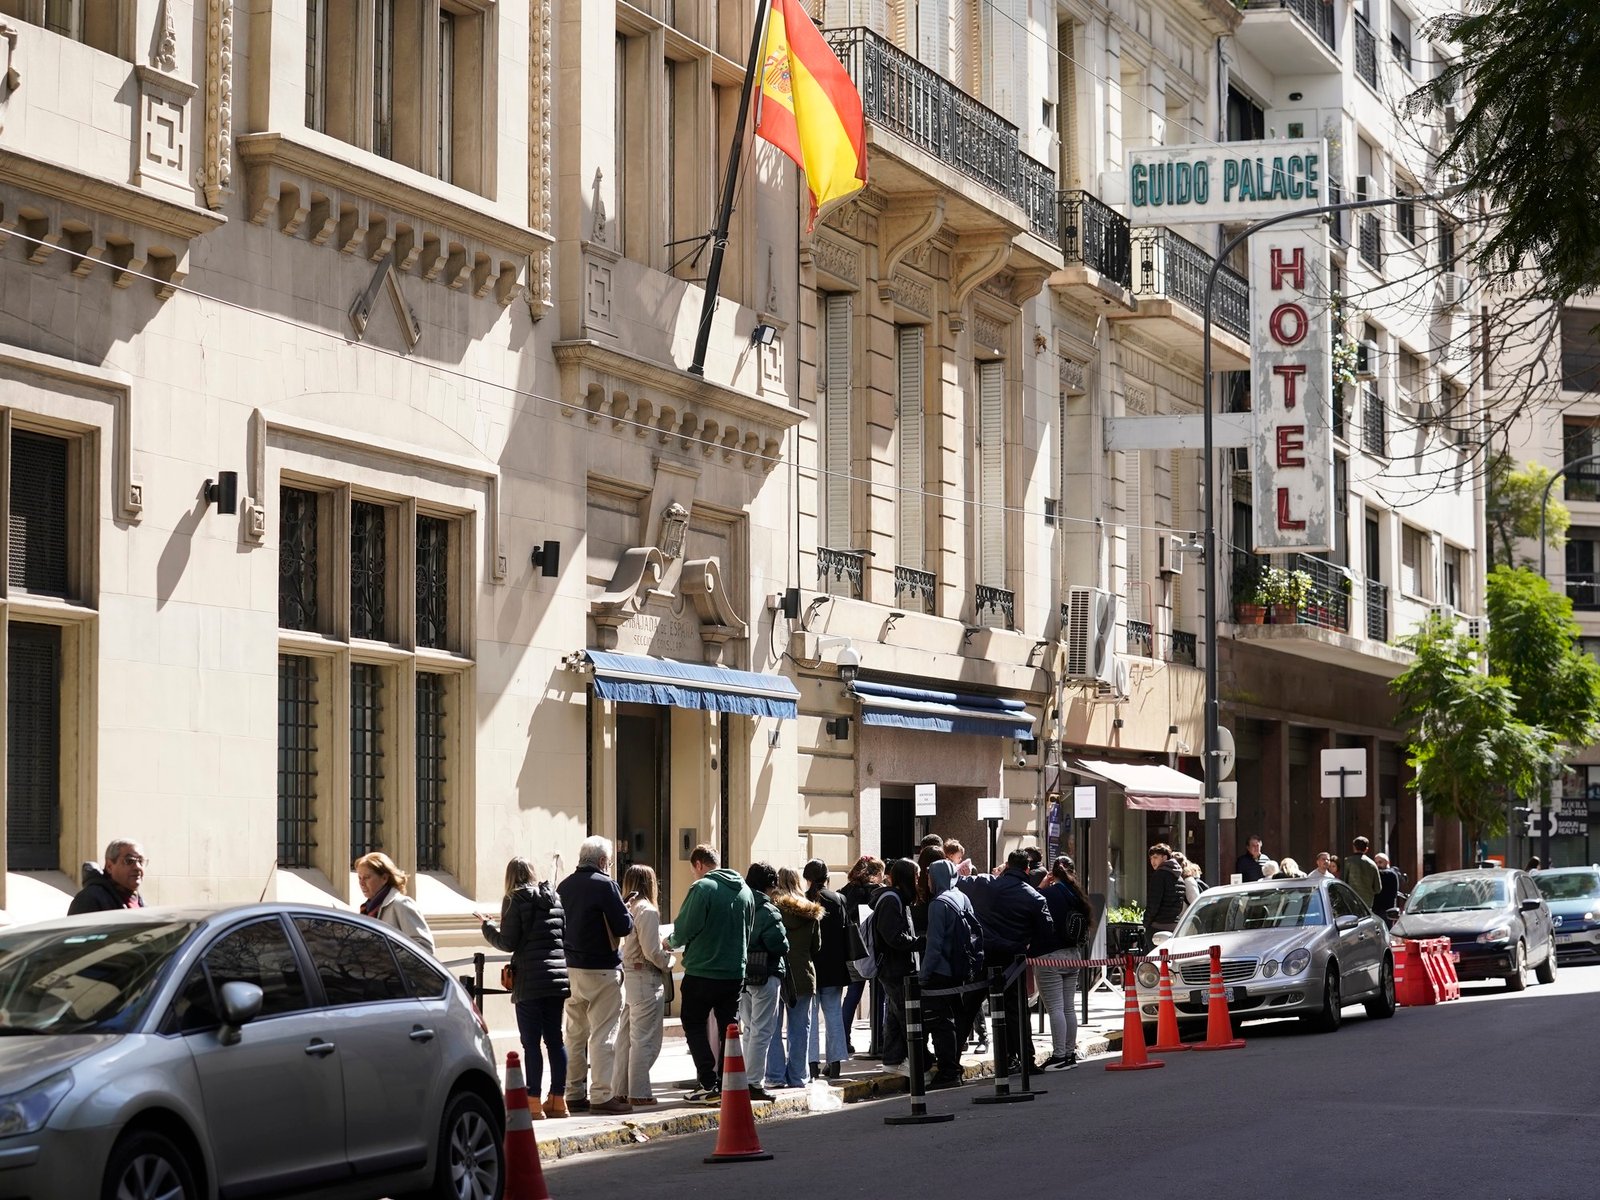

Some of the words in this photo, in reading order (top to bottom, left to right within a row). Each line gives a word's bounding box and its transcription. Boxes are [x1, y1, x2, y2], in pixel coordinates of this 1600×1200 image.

[1132, 161, 1209, 207] GUIDO
[1224, 155, 1319, 202] PALACE
[1269, 247, 1308, 531] HOTEL
